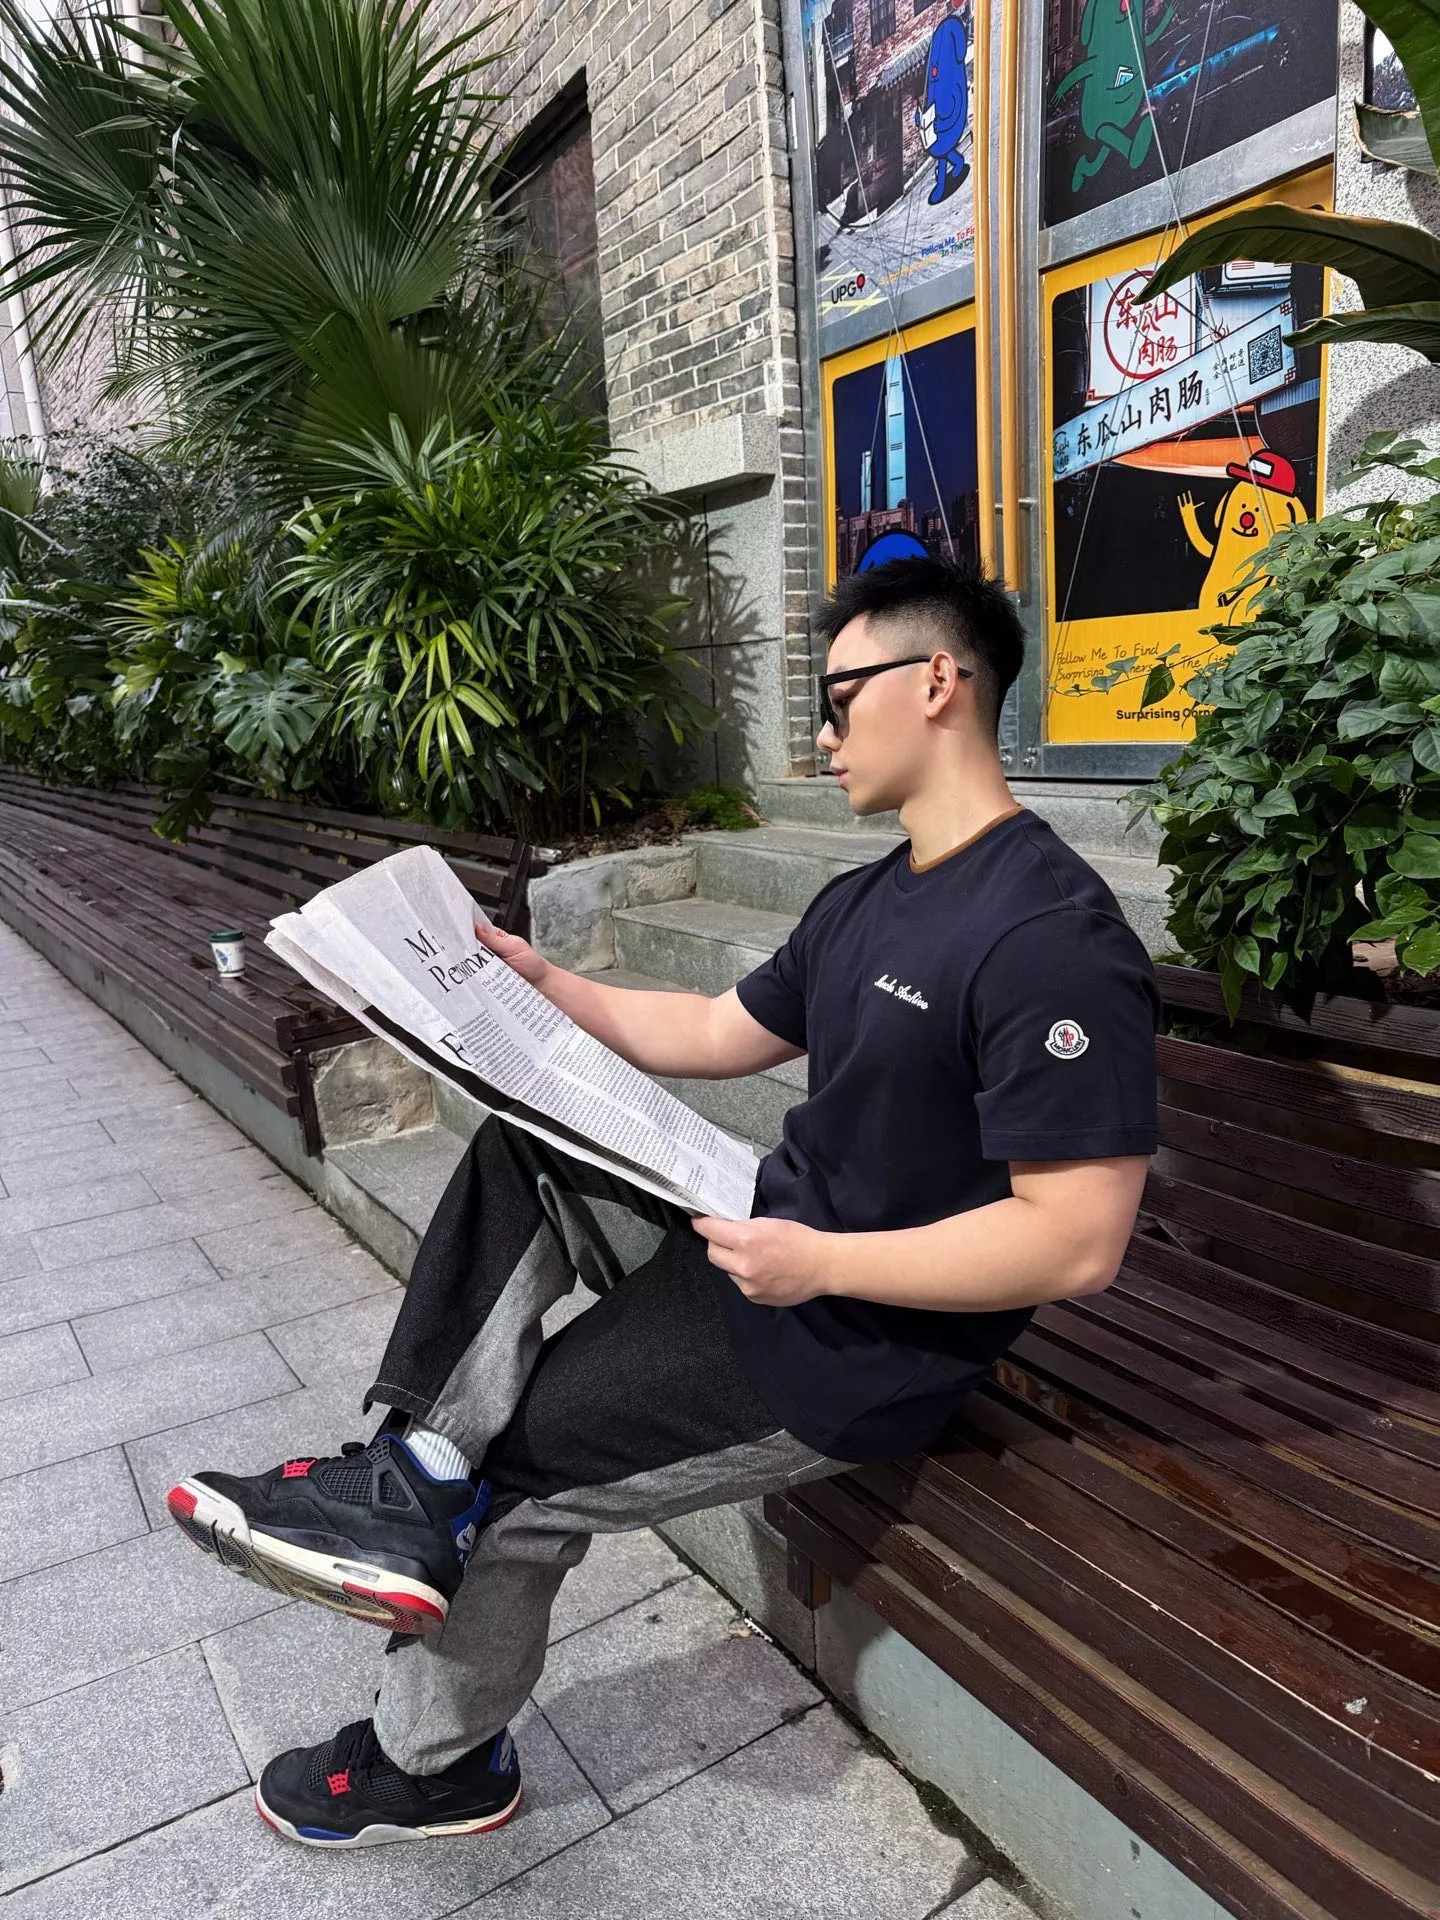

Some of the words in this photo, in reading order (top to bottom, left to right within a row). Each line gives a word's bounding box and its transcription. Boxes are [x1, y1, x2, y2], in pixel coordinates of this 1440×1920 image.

[921, 241, 945, 257] Follow
[944, 236, 956, 247] Me
[956, 231, 966, 242] To
[950, 242, 963, 254] The
[1077, 370, 1203, 457] 东瓜山肉肠
[1056, 650, 1086, 666] Follow
[1091, 647, 1108, 661] Me
[1114, 645, 1127, 658] To
[1133, 642, 1159, 657] Find
[1116, 707, 1181, 721] Surprising
[1182, 707, 1211, 719] Corn
[1053, 1041, 1083, 1053] MONCLER
